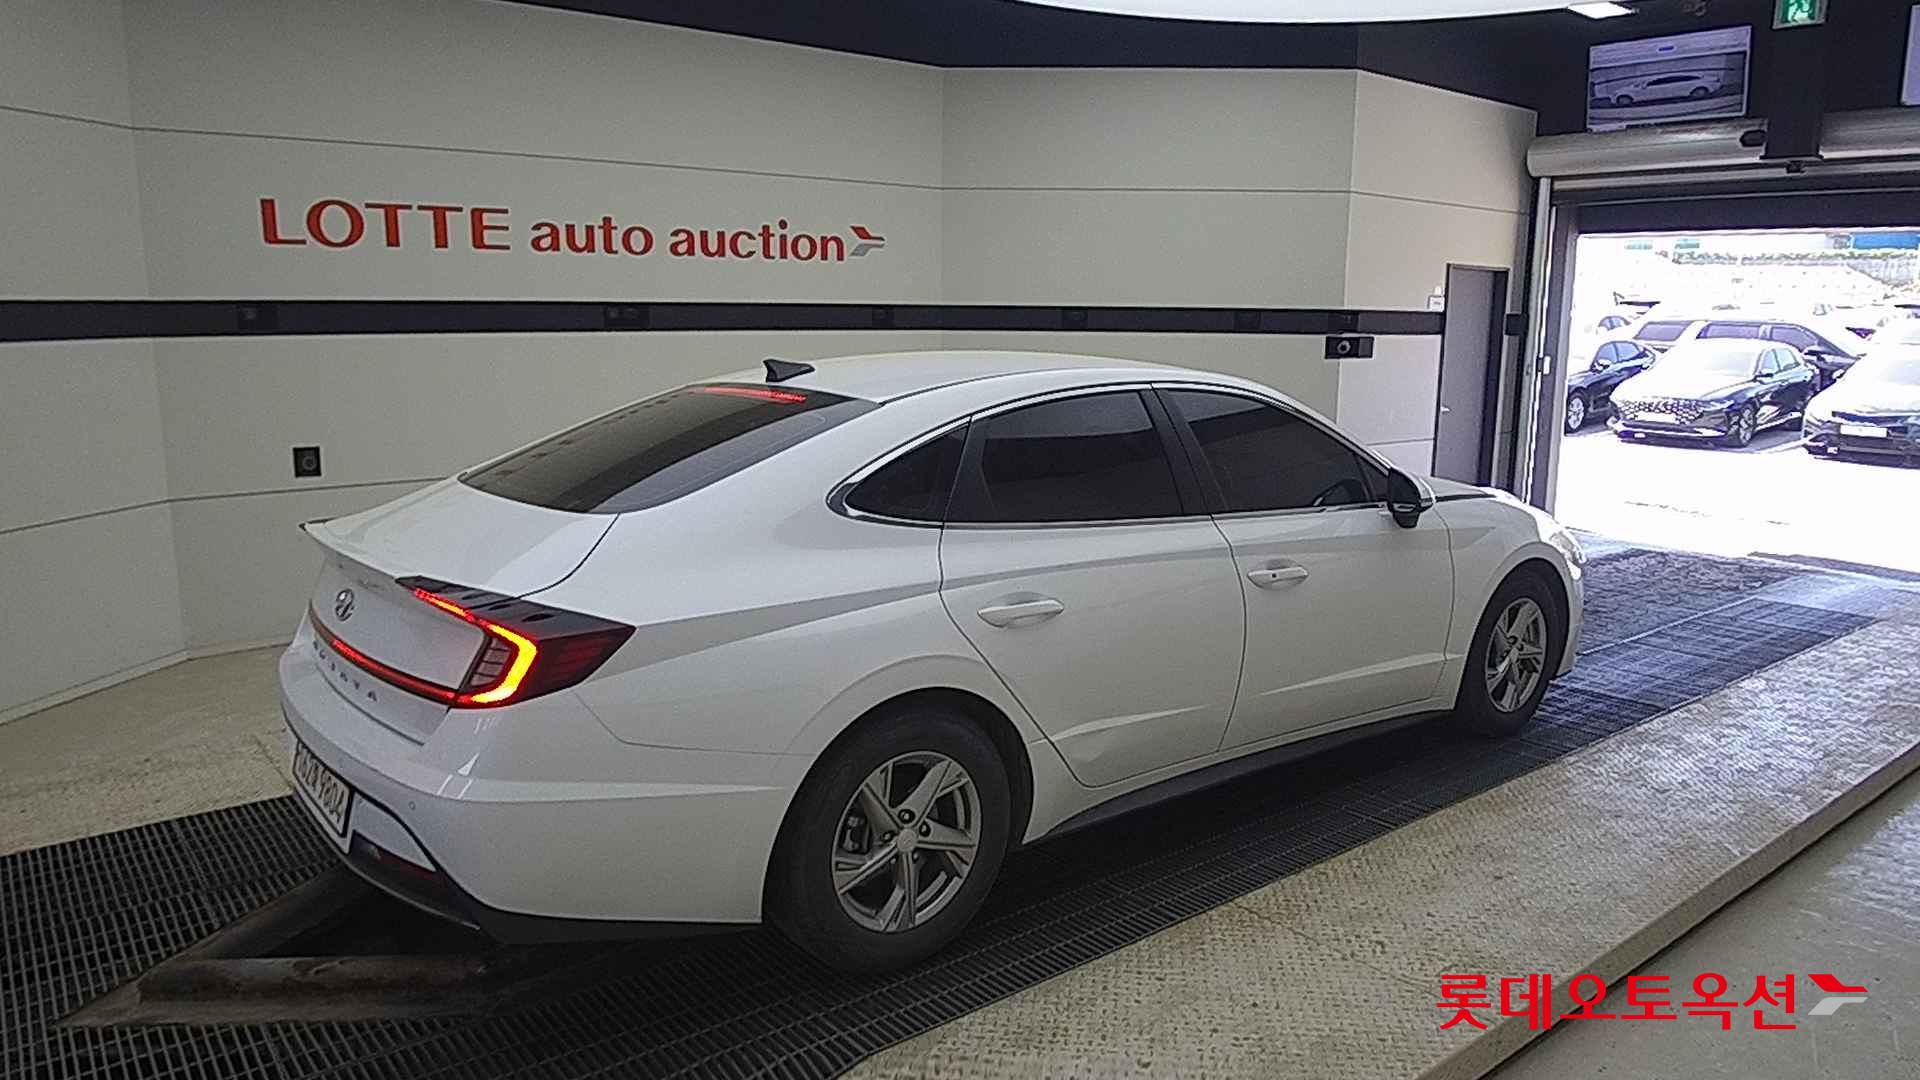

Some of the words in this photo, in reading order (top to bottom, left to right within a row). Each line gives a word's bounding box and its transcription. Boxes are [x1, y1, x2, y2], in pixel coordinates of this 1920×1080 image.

[260, 198, 511, 251] LOTTE
[530, 217, 654, 256] auto
[671, 219, 845, 261] auction
